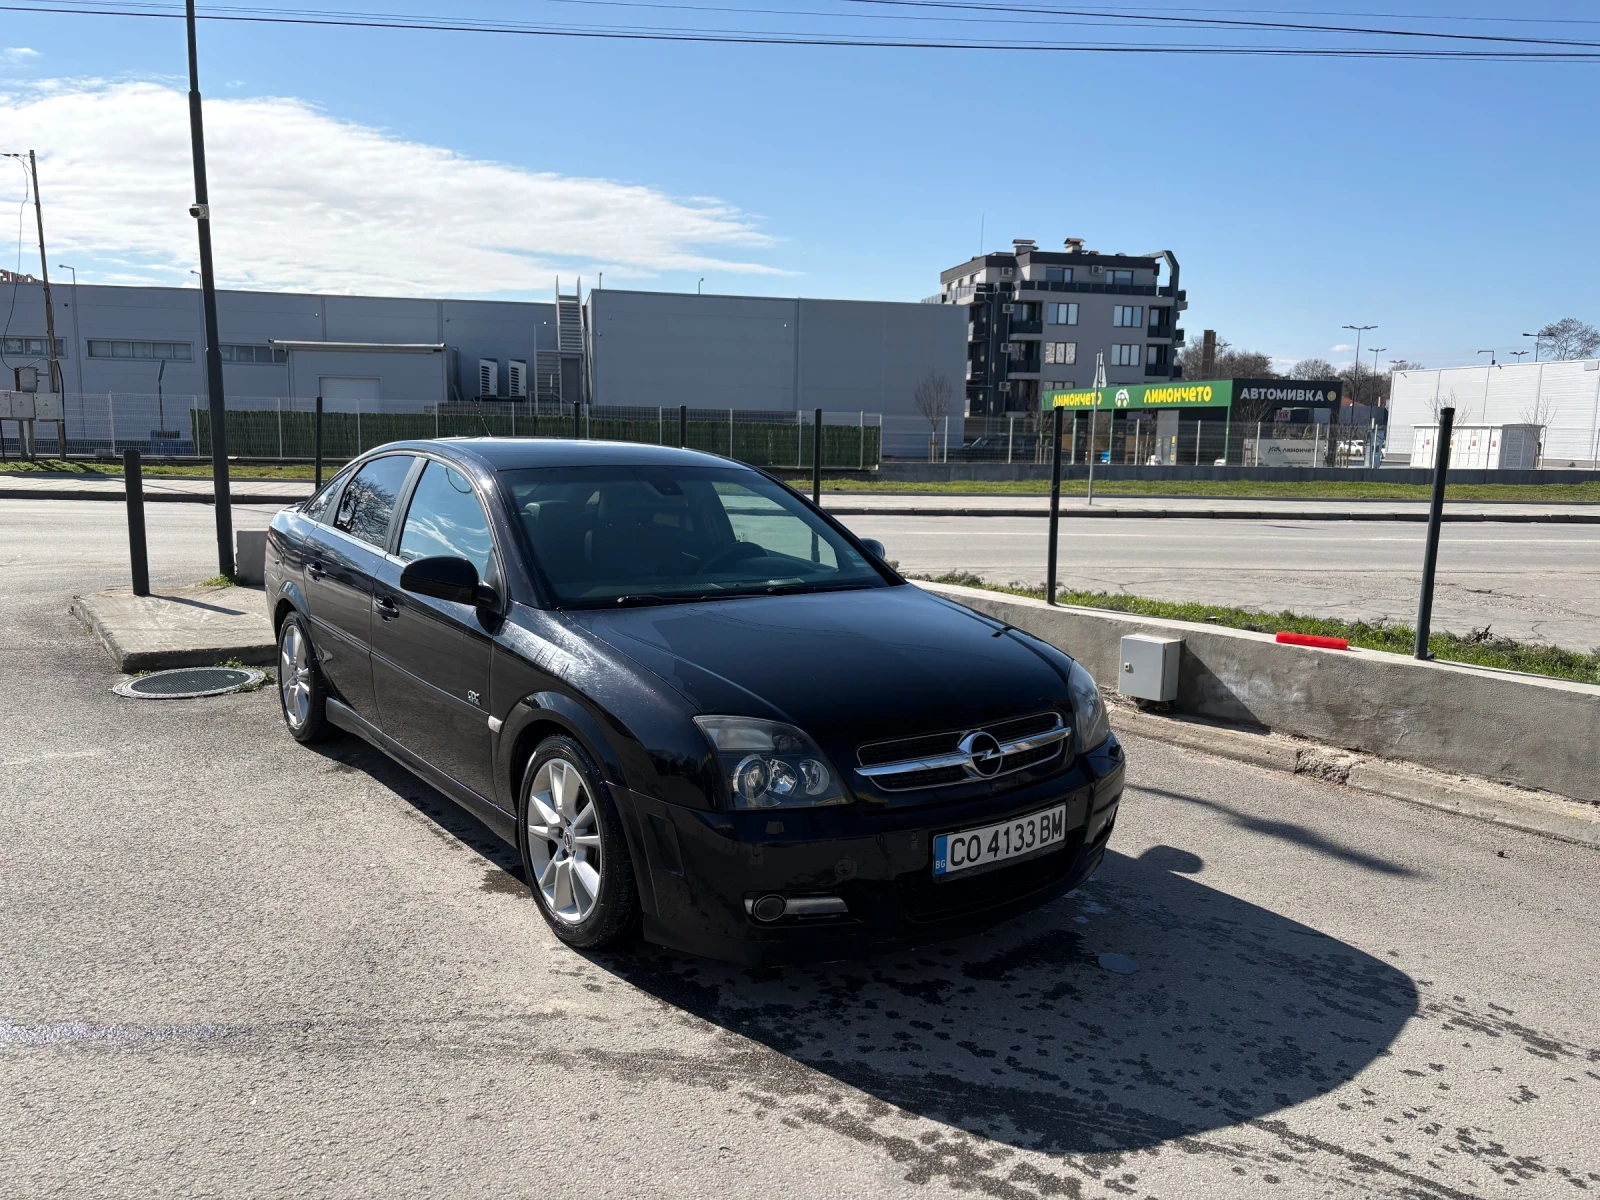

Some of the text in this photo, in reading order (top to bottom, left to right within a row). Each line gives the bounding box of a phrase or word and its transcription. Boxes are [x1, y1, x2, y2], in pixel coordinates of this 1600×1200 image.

[1240, 388, 1324, 401] АВТОМИВКА
[950, 834, 982, 867] CO
[987, 819, 1036, 858] 4133
[1039, 809, 1064, 845] BM
[935, 859, 946, 869] BG
